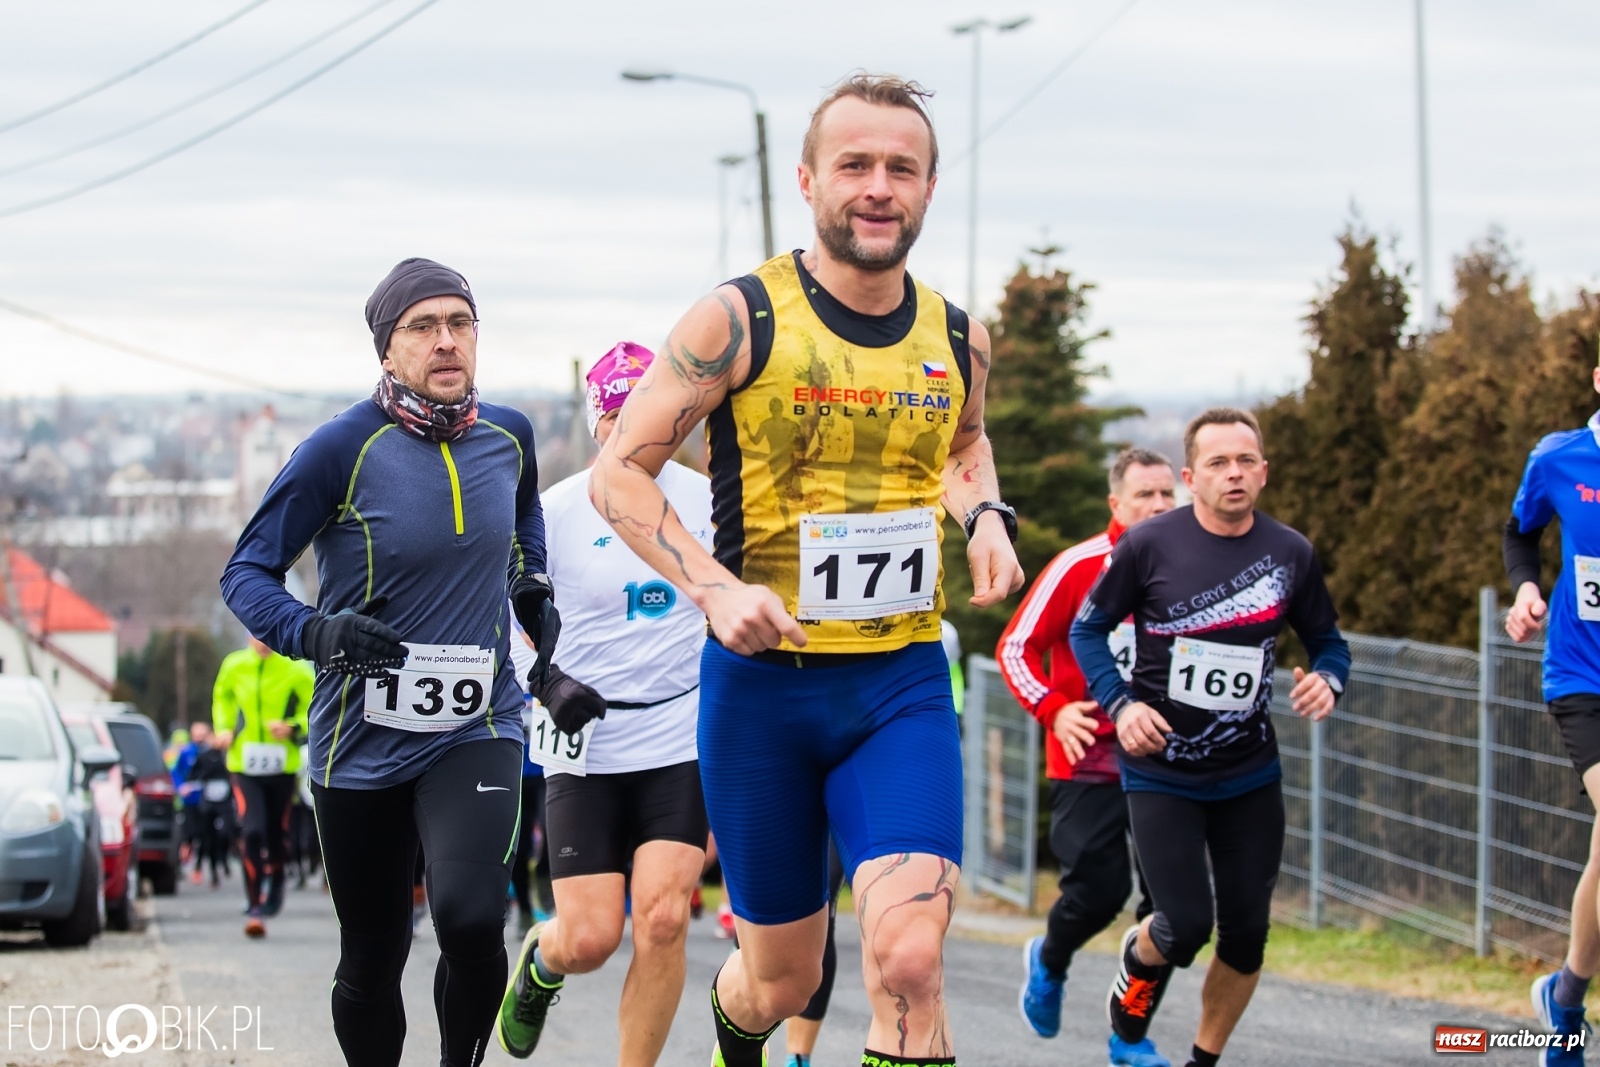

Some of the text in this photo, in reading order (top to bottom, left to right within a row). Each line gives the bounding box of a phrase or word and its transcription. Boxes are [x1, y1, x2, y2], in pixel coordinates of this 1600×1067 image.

[602, 377, 630, 399] XIII
[794, 387, 888, 405] ENERGY
[894, 392, 951, 410] TEAM
[793, 404, 950, 424] BOLATICE
[855, 519, 933, 535] www.personalbest.pl
[593, 536, 613, 548] 4F
[813, 548, 924, 600] 171
[1167, 554, 1277, 619] KS GRYF KIETRZ
[414, 655, 490, 664] www.personalbest.pl
[1179, 664, 1254, 700] 169
[376, 673, 483, 716] 139
[536, 719, 584, 760] 119
